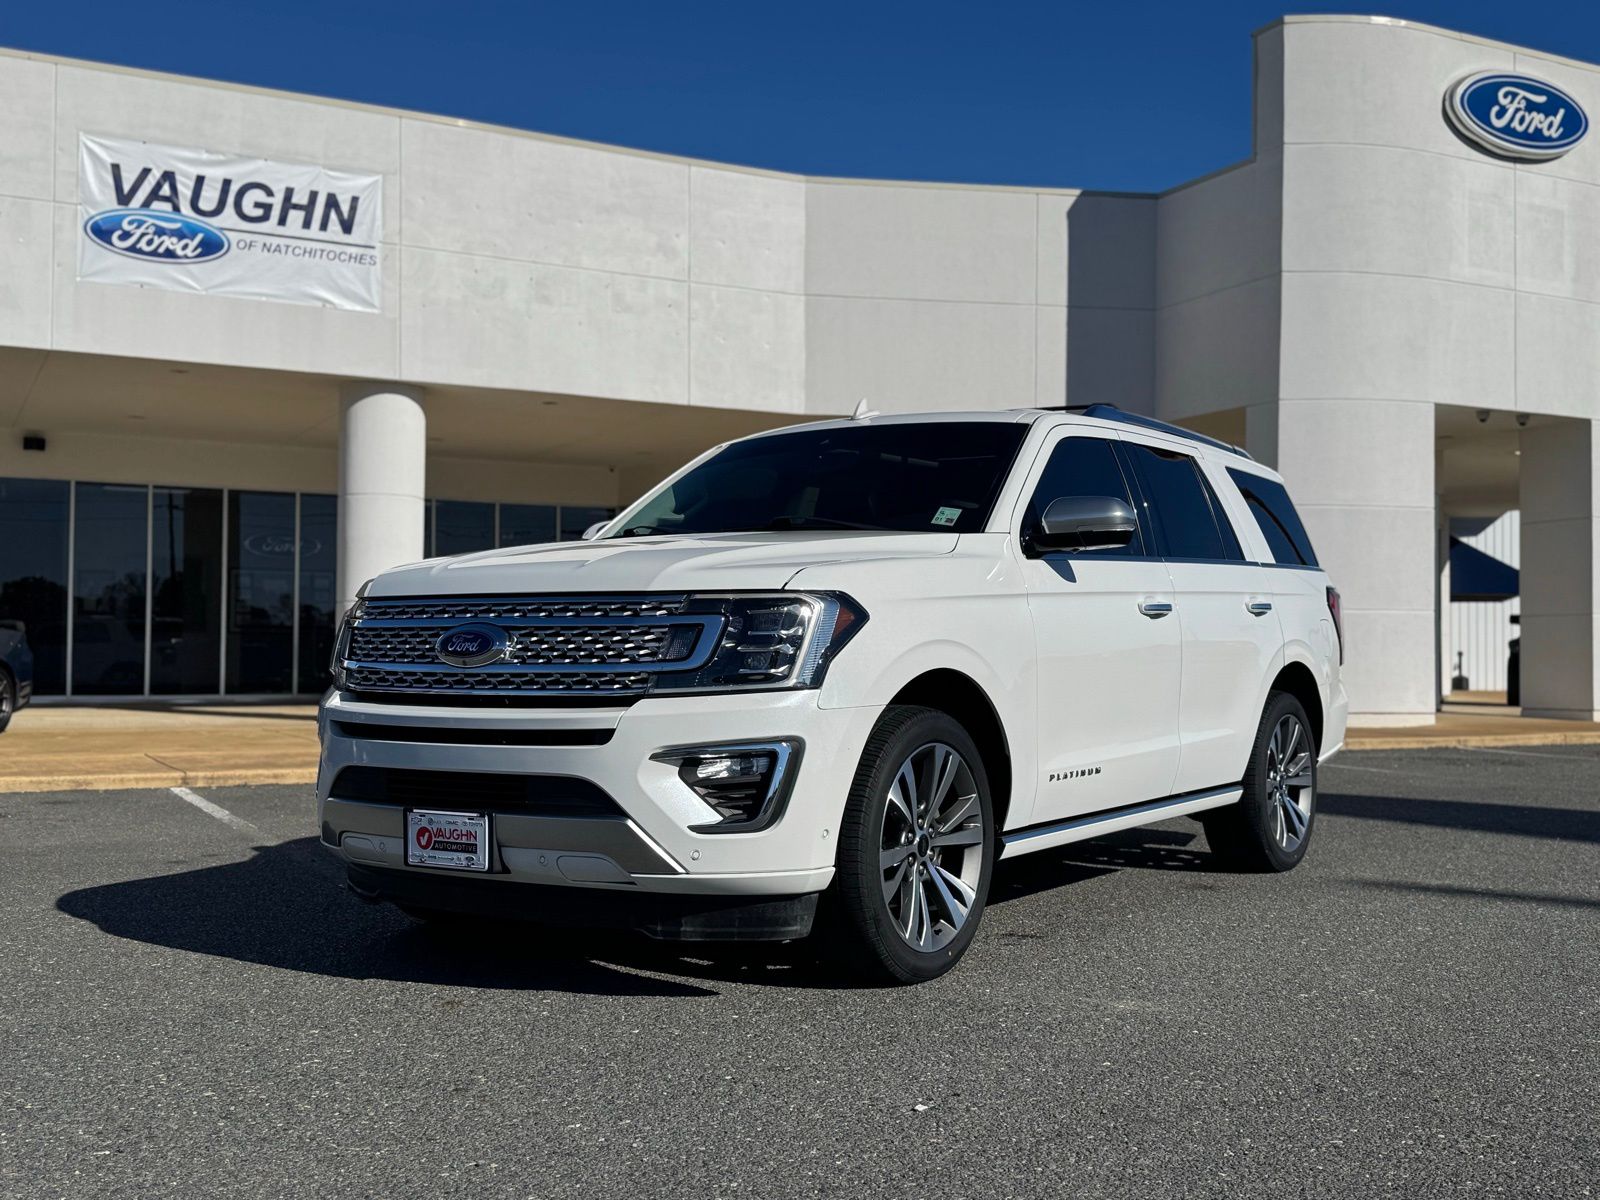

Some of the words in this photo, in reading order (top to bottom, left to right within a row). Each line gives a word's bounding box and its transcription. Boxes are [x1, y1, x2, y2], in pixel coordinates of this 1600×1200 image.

[1489, 86, 1566, 139] Ford
[110, 162, 360, 236] VAUGHN
[111, 214, 203, 259] Ford
[236, 238, 258, 252] OF
[261, 241, 378, 267] NATCHITOCHES
[447, 633, 482, 652] Ford
[1048, 766, 1102, 783] PLATINUM
[431, 827, 478, 842] VAUGHN
[434, 842, 477, 852] AUTOMOTIVE
